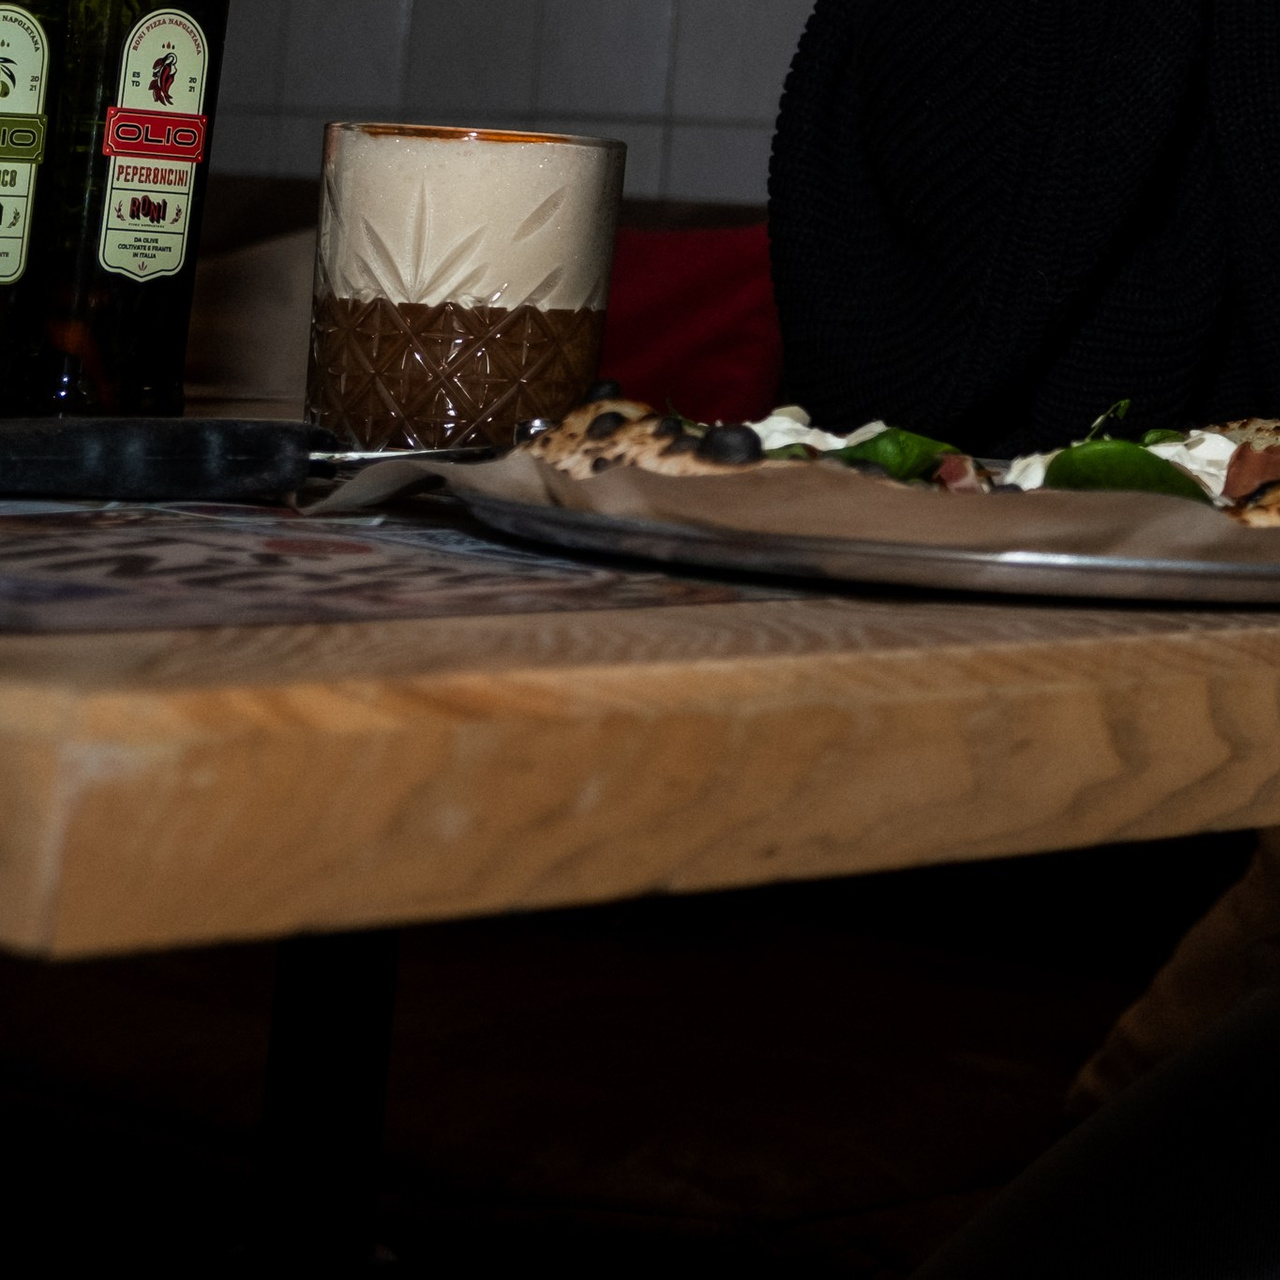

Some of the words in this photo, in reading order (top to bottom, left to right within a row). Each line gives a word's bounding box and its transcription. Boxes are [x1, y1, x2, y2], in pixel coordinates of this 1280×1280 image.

[2, 15, 40, 53] NAPOLETANA
[145, 18, 167, 33] PIZZA
[168, 18, 203, 56] NAPOLETANA
[30, 75, 40, 83] 20
[188, 76, 198, 84] 20
[115, 123, 198, 147] OLIO
[117, 165, 188, 187] PEPERONCINI
[130, 195, 167, 223] RONI
